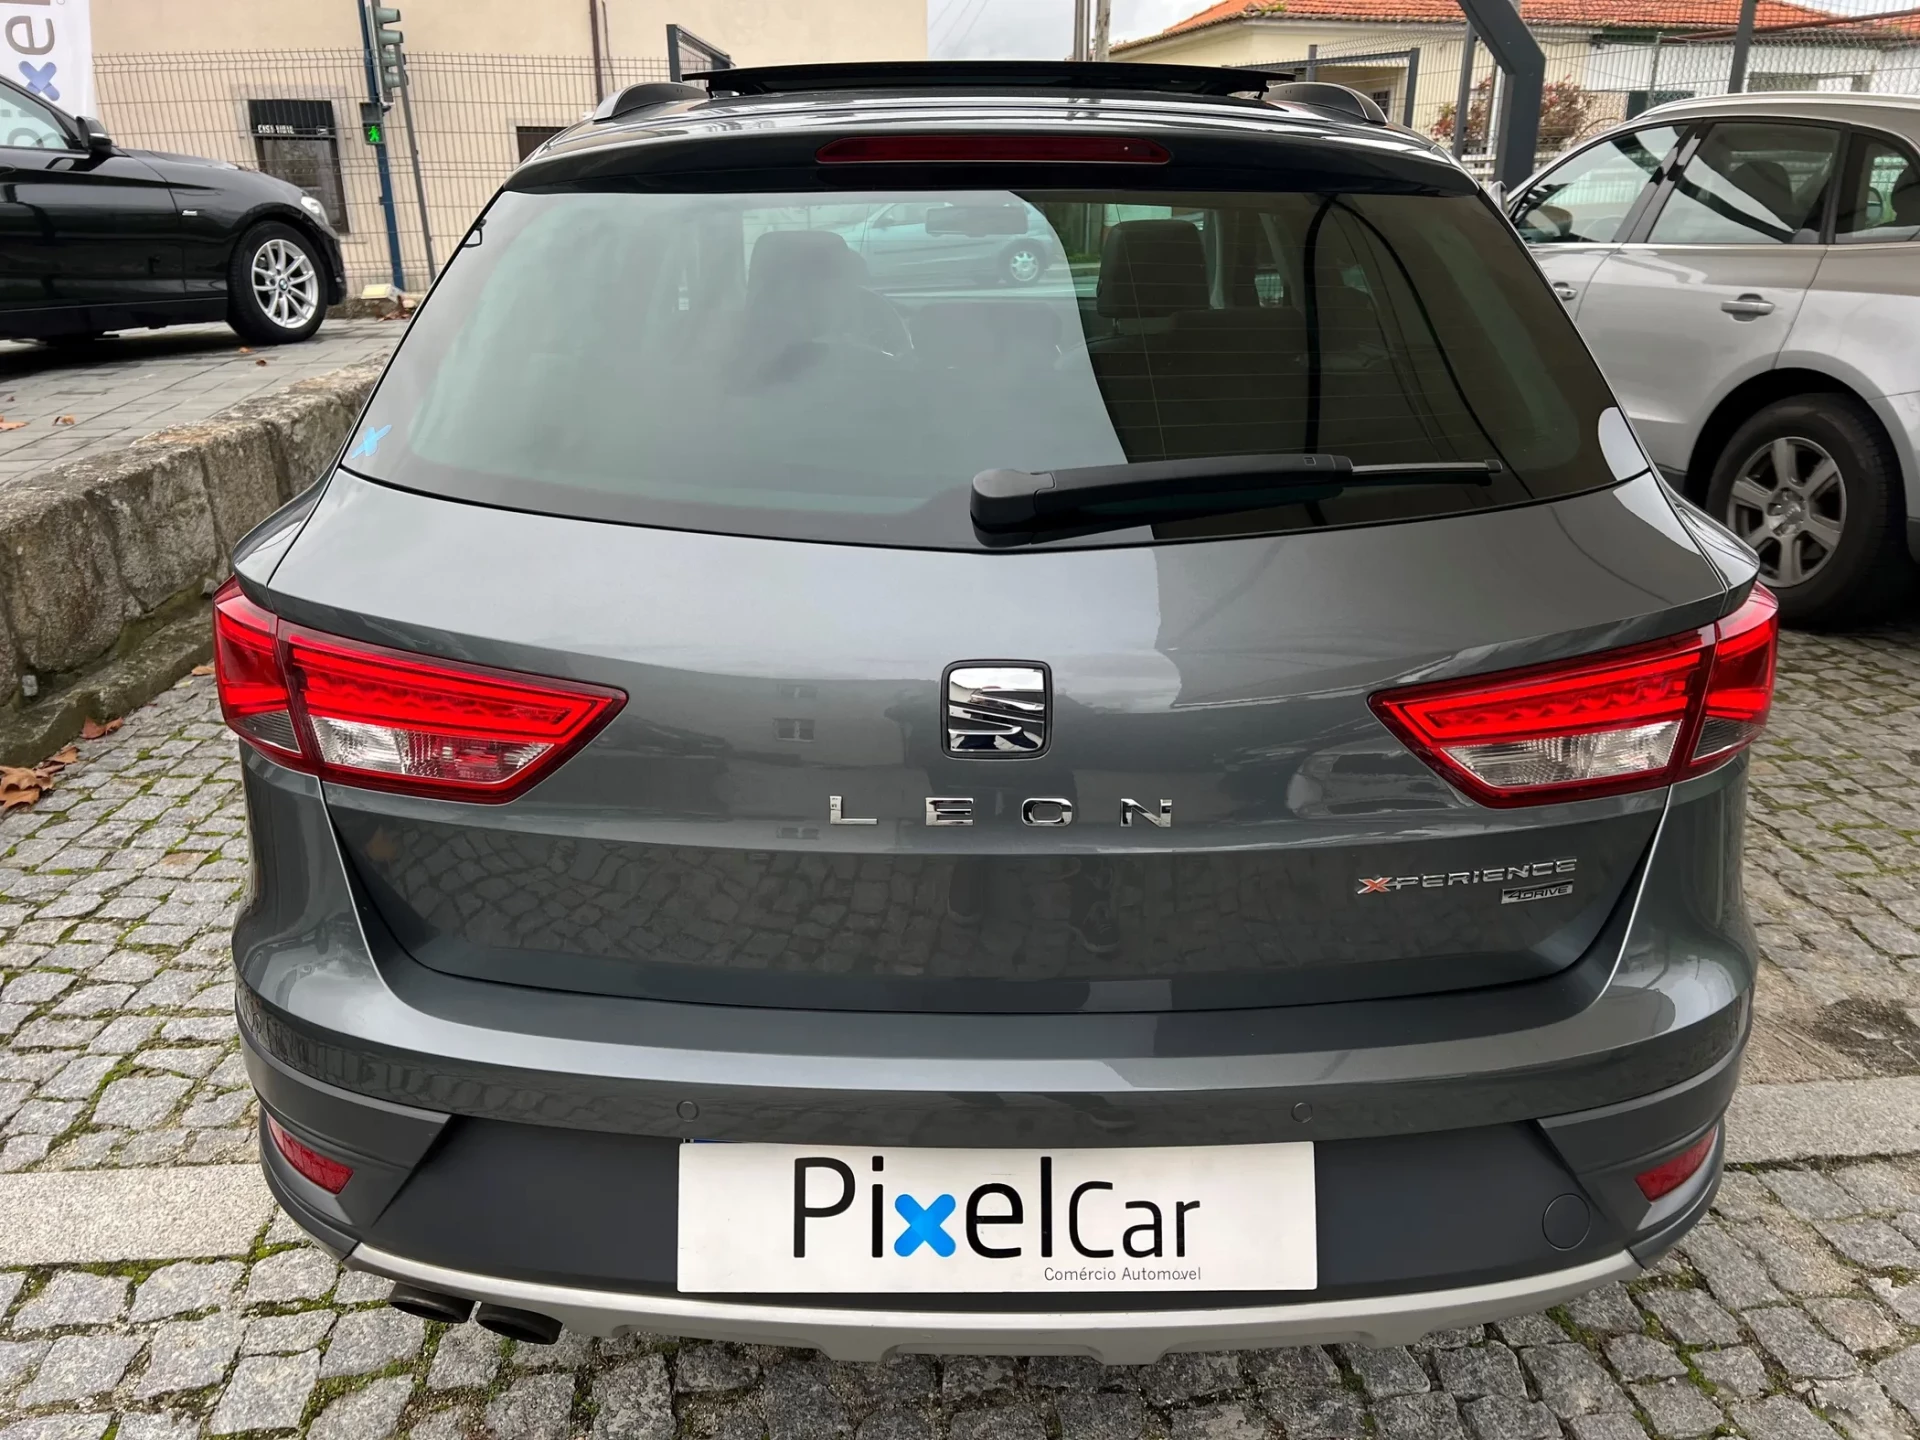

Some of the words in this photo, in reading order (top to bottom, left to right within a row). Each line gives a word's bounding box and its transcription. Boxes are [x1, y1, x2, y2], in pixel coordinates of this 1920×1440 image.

[829, 795, 1172, 828] LEON
[1507, 884, 1571, 901] 4DRIVE
[793, 1155, 1201, 1259] PixelCar
[1043, 1266, 1117, 1281] Comércio
